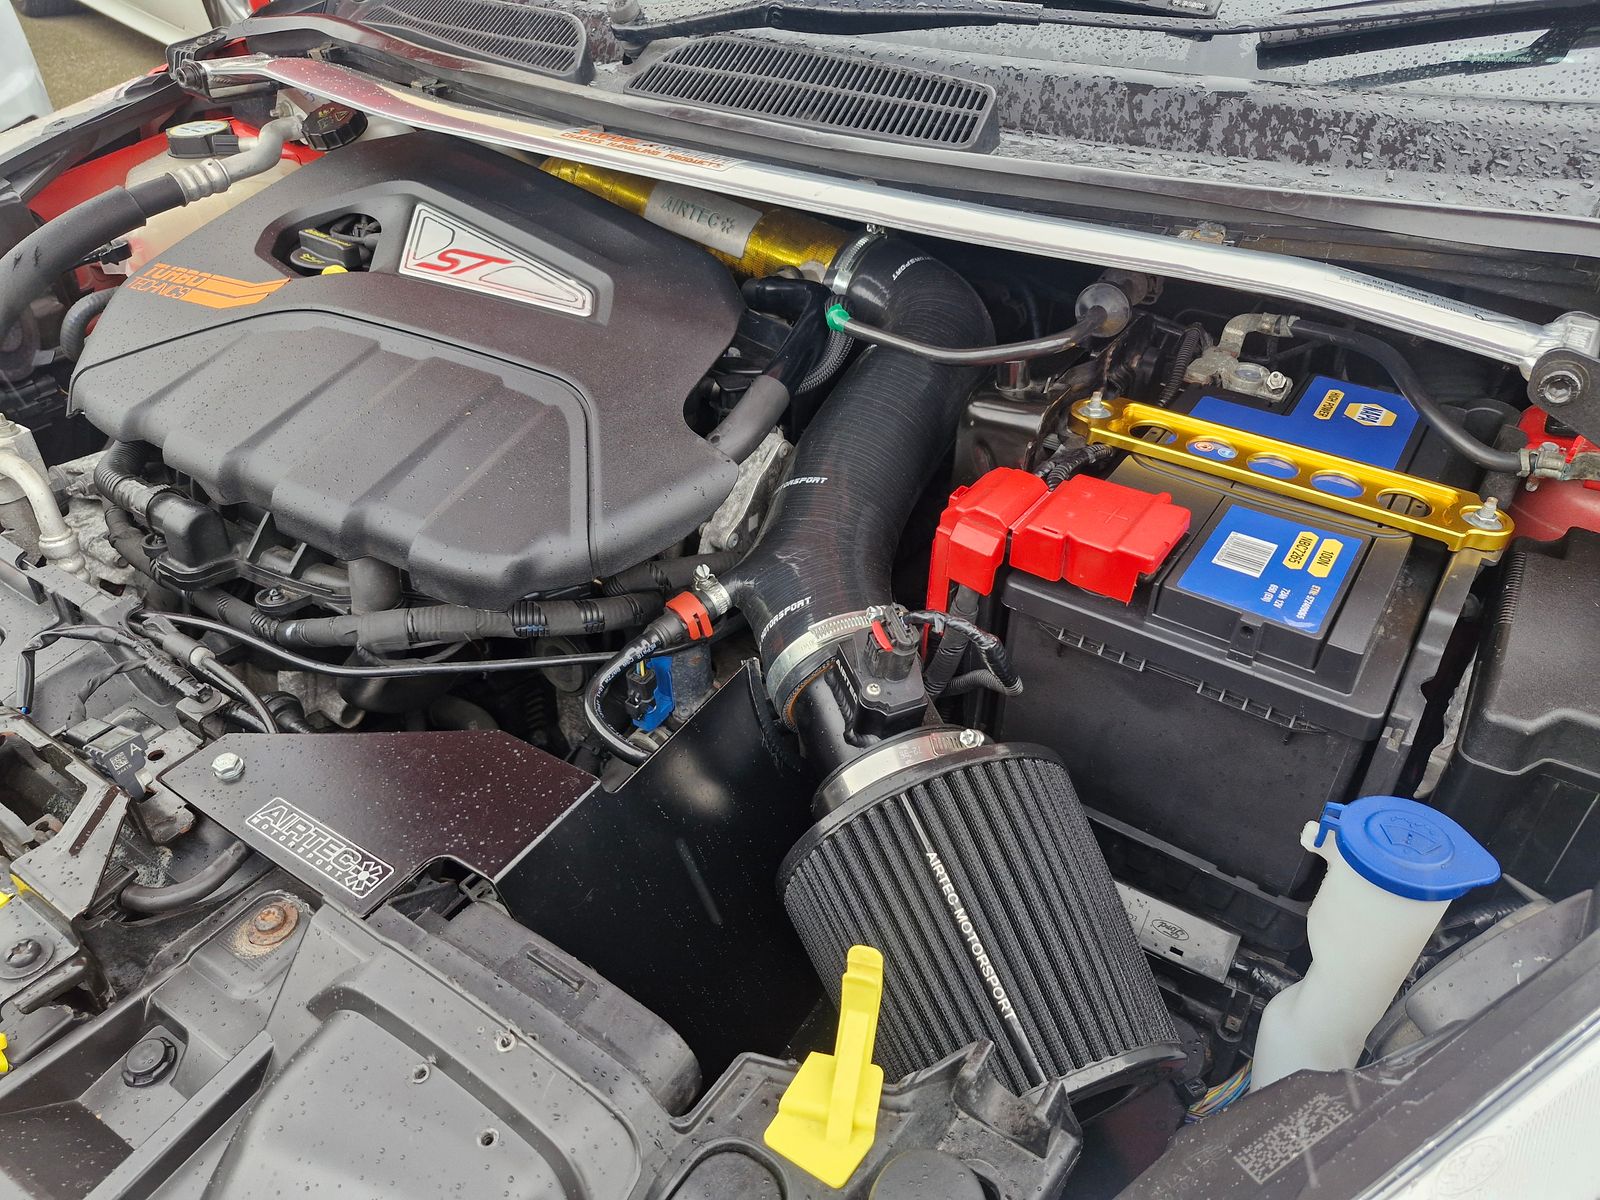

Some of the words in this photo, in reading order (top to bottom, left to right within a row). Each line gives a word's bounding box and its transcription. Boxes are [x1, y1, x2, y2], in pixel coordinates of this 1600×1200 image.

[560, 132, 602, 145] CHASSIS
[608, 142, 661, 156] HANDLING
[664, 153, 725, 168] PRODUCTS
[660, 195, 720, 229] AIRTEC
[143, 262, 209, 288] TURBO
[413, 249, 514, 275] ST
[127, 276, 193, 299] TECHNICS
[1318, 401, 1335, 418] POWER
[1357, 406, 1383, 424] NAPA
[1289, 536, 1313, 564] NBC7265
[1317, 550, 1335, 567] 100N
[836, 659, 858, 705] AIRTEC
[130, 742, 142, 757] A
[252, 816, 343, 878] MOTORSPORT
[257, 805, 362, 872] AIRTEC
[926, 852, 959, 906] AIRTEC
[954, 908, 1016, 1020] MOTORSPORT
[1157, 921, 1185, 940] Ford
